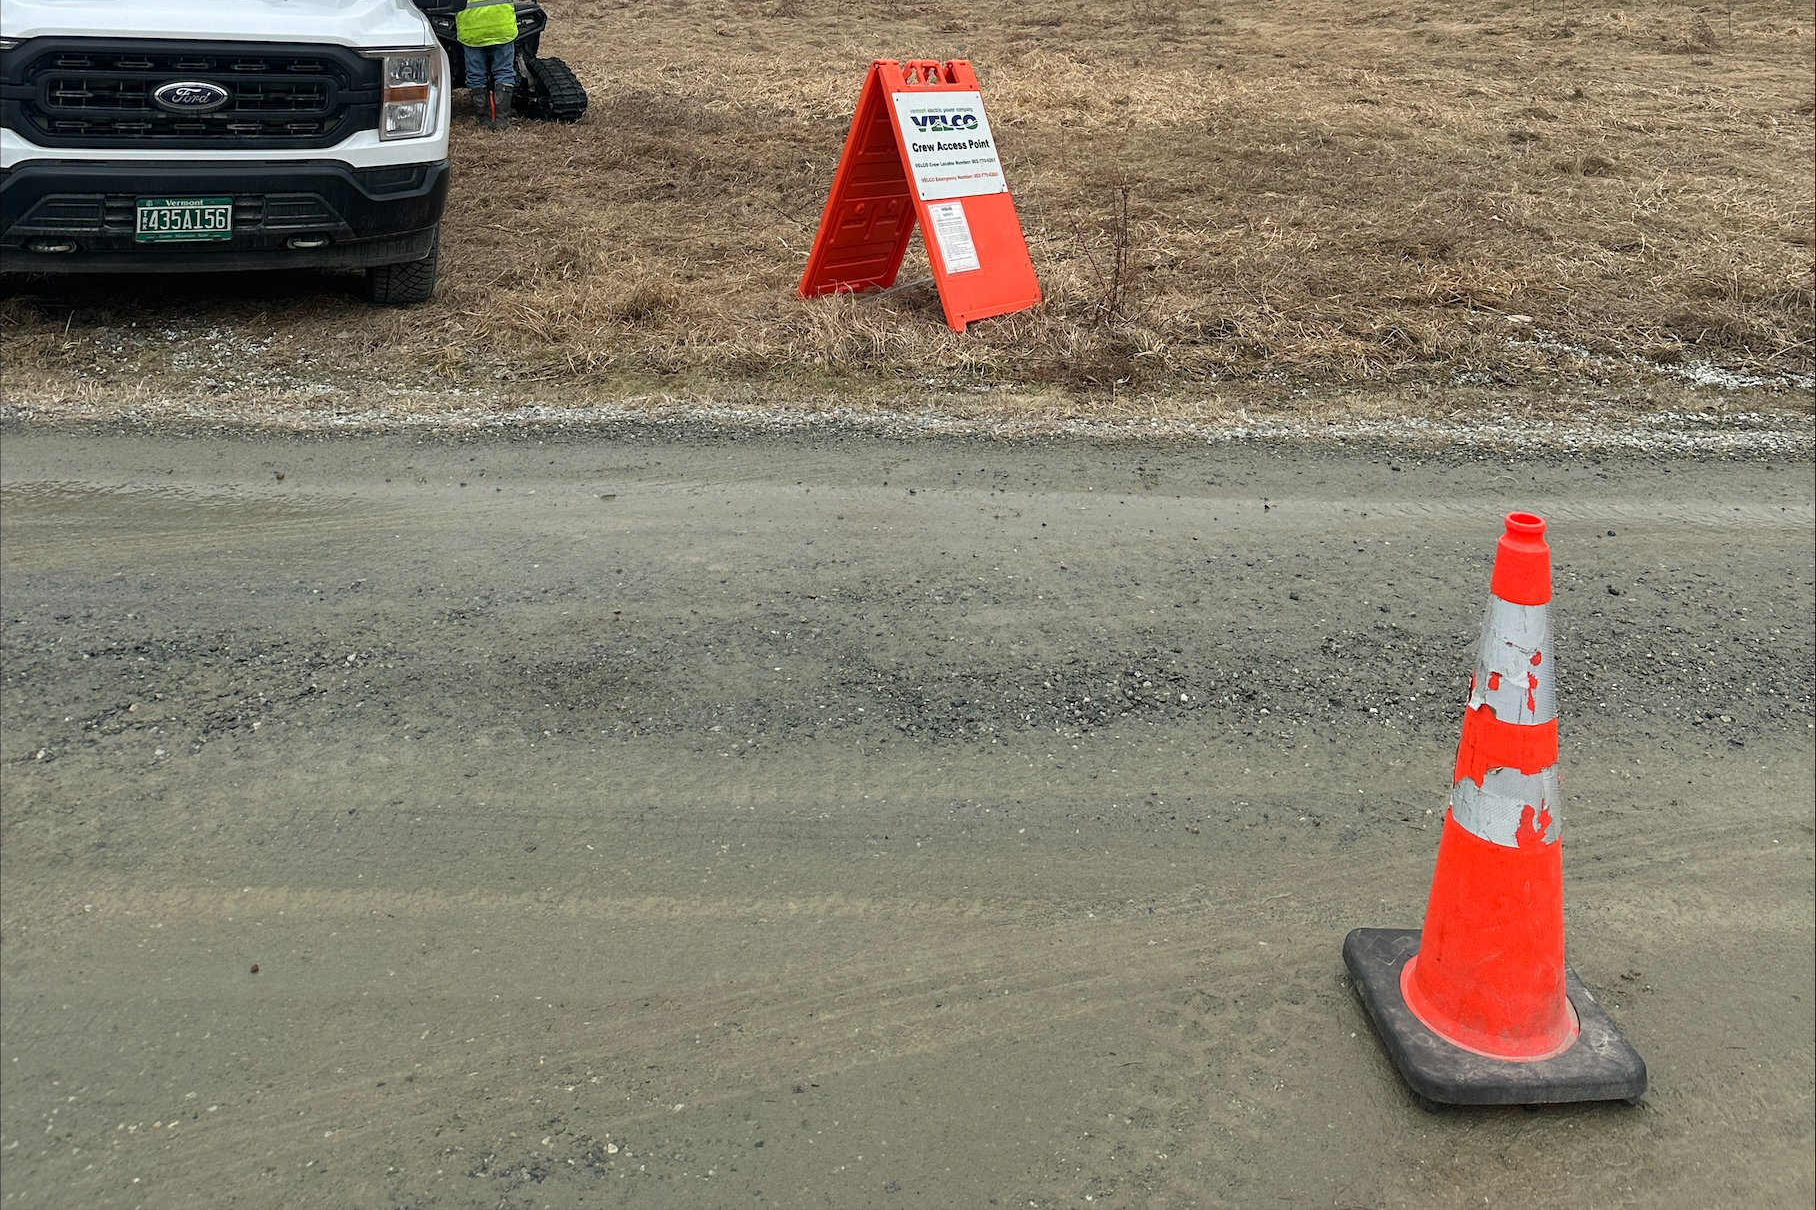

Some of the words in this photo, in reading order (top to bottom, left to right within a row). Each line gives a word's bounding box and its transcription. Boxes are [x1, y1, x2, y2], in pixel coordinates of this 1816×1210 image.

[172, 87, 211, 103] Ford
[910, 114, 978, 132] VELCO
[912, 142, 935, 152] Crew
[937, 141, 967, 151] Access
[968, 139, 990, 149] Point
[149, 209, 226, 230] 435A156
